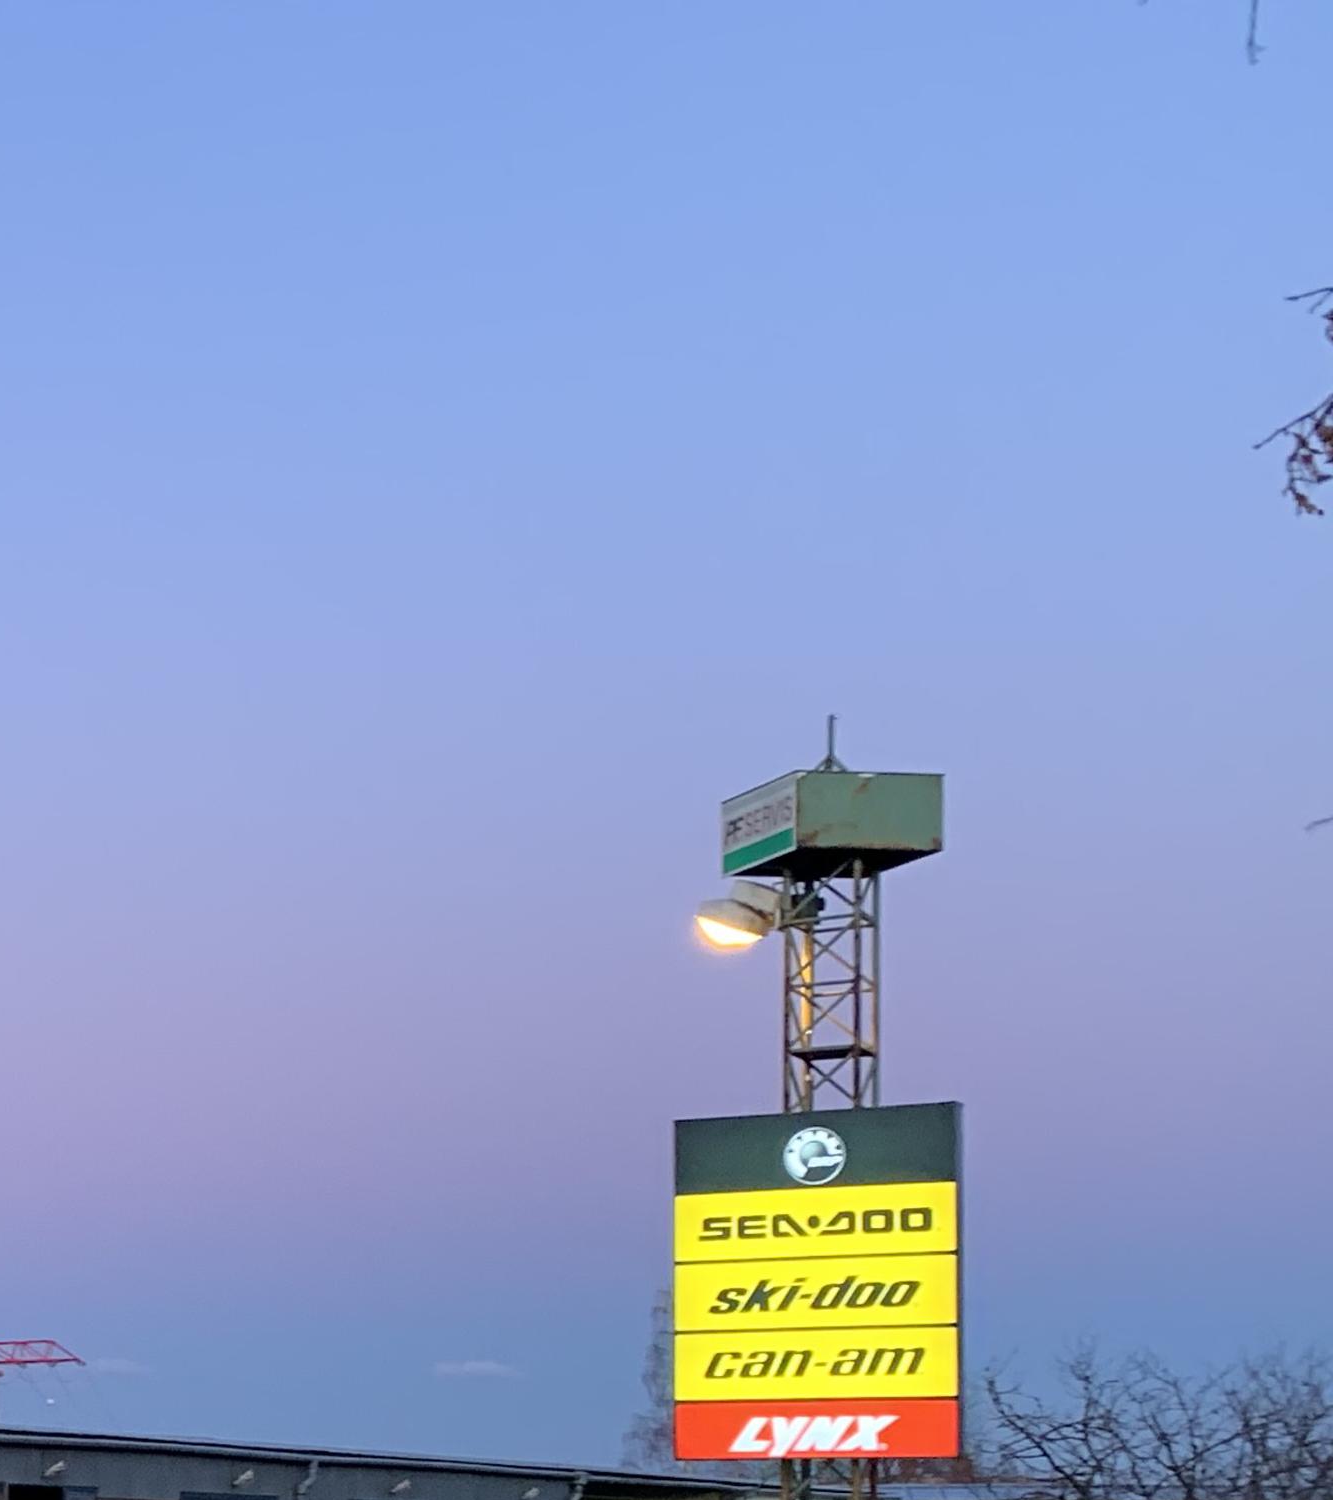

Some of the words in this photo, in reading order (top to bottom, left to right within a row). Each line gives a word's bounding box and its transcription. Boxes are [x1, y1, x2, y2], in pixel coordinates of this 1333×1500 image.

[709, 1275, 921, 1315] ski-doo
[704, 1347, 926, 1380] can-am
[729, 1414, 900, 1458] LYNX
